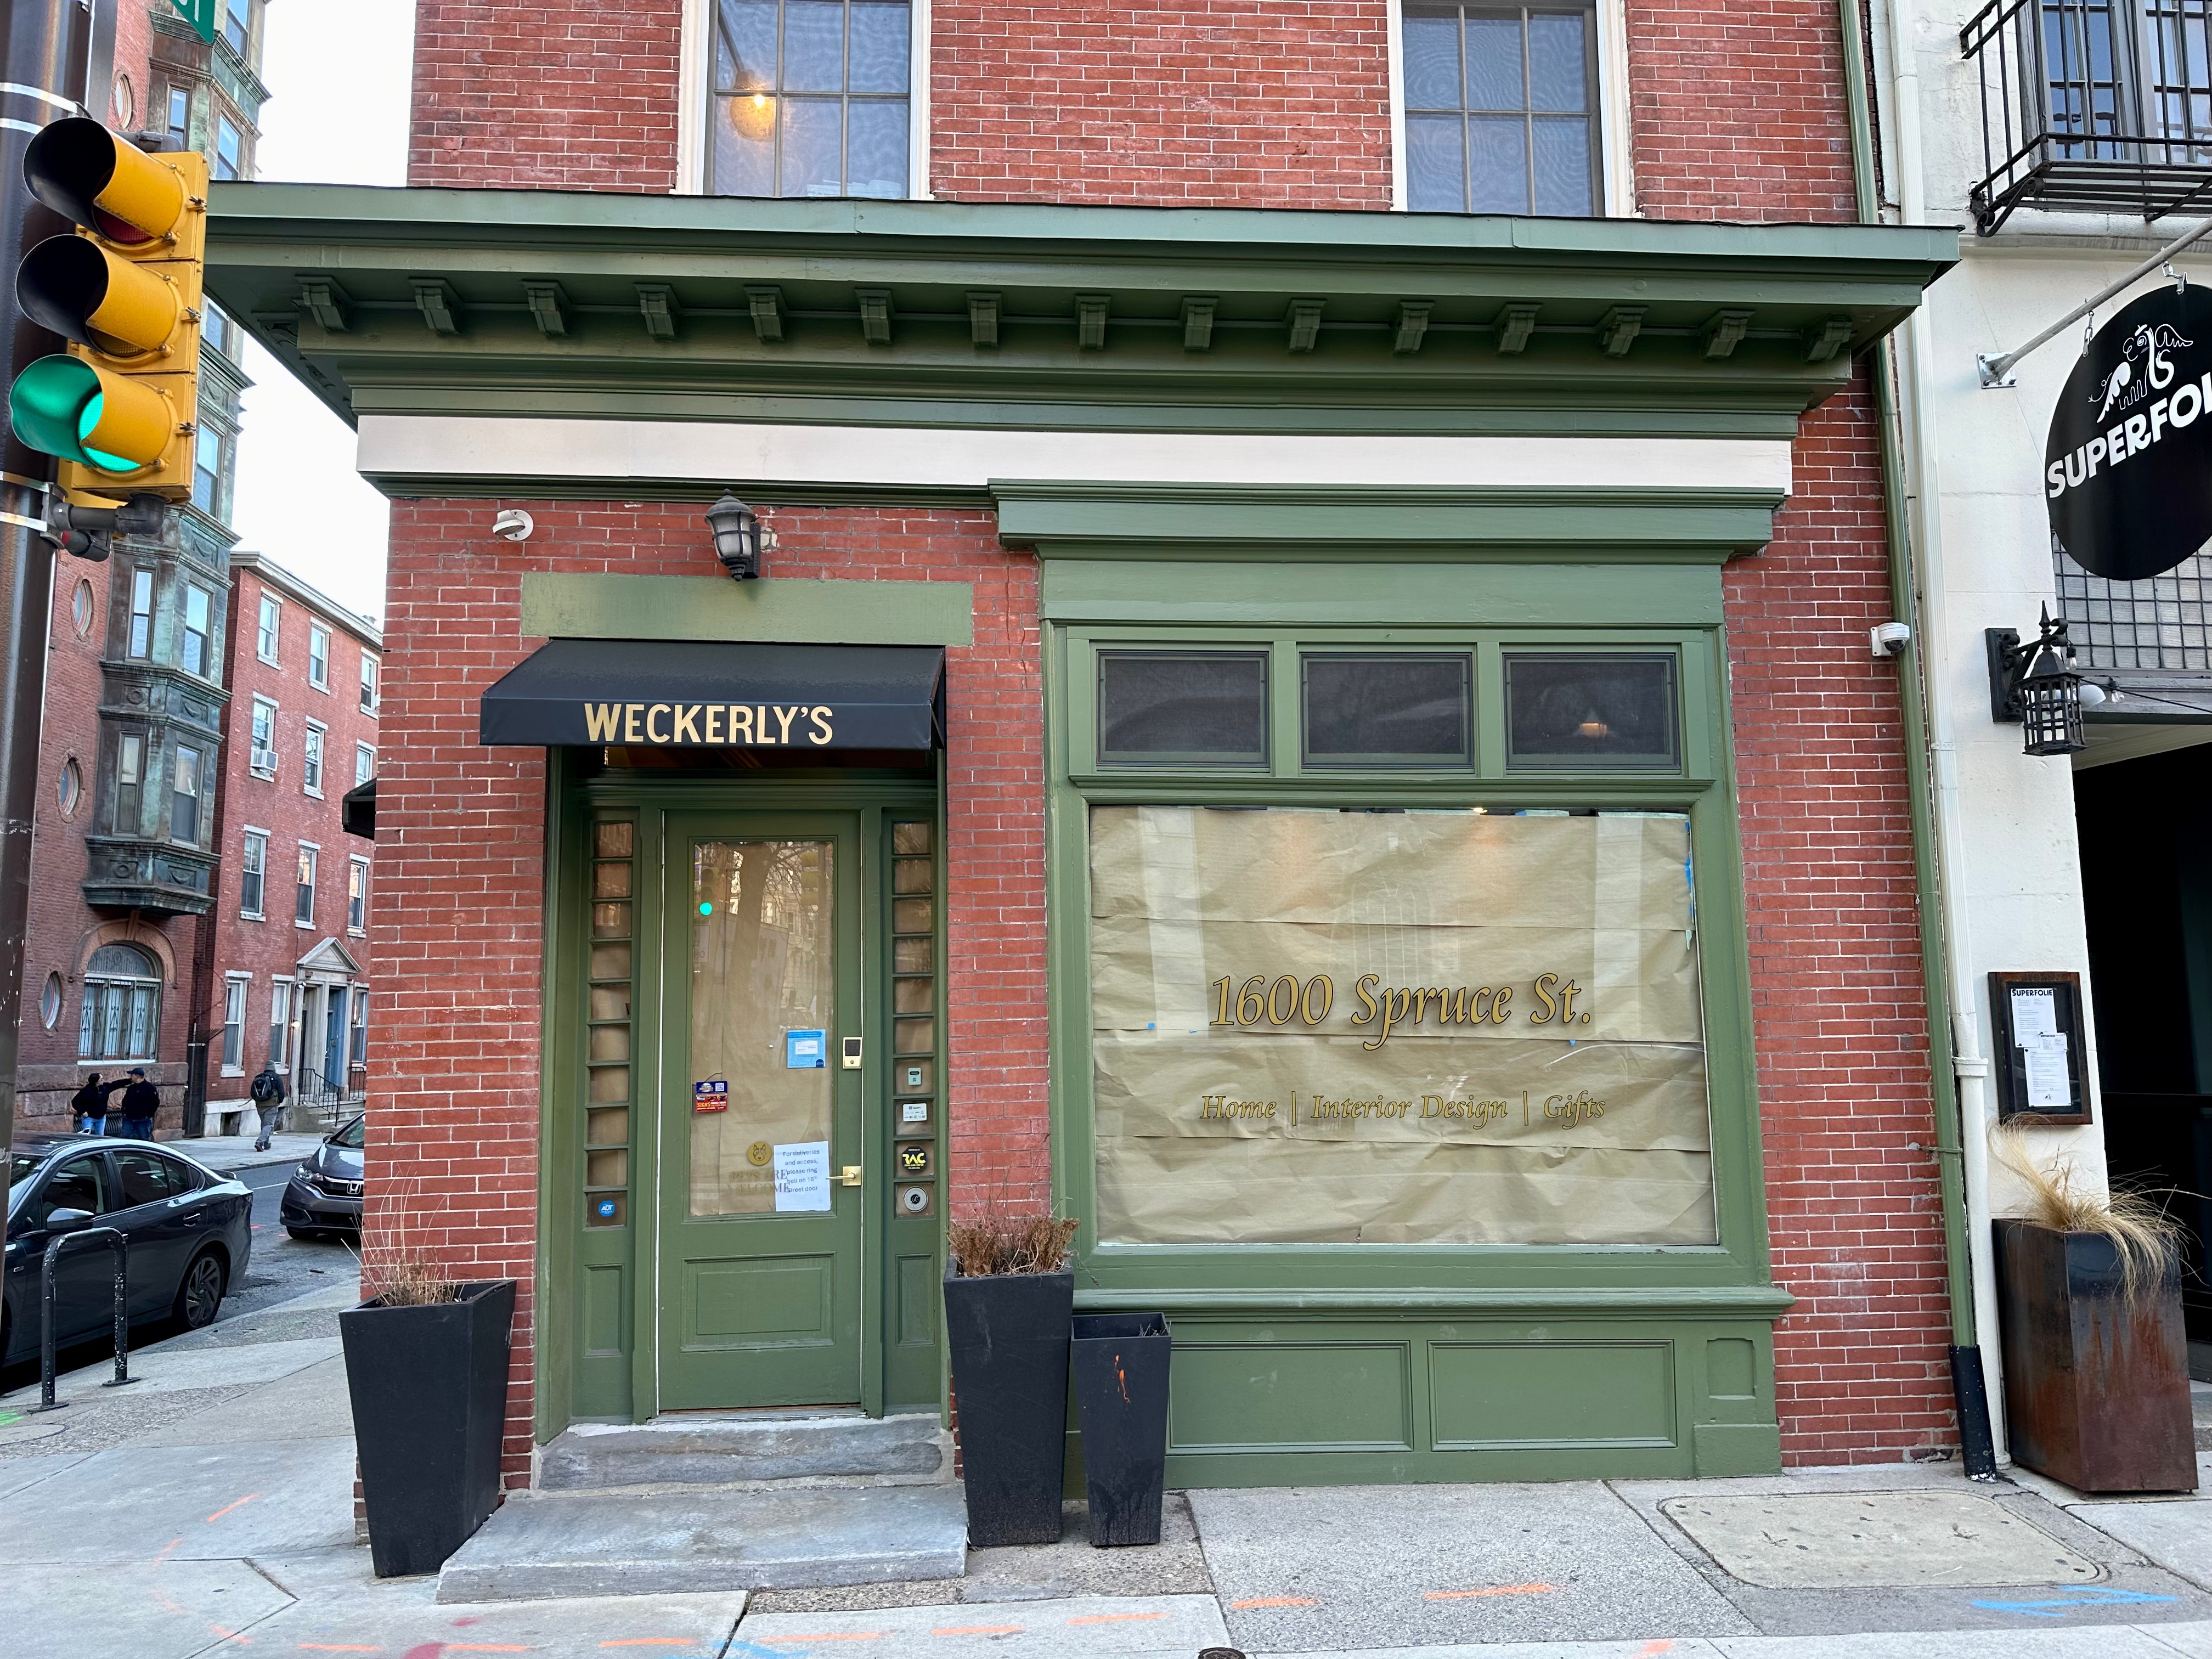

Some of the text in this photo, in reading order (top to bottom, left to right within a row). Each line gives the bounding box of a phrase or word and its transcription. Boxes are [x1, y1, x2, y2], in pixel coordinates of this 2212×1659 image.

[584, 703, 833, 744] WECKERLY'S
[1209, 973, 1592, 1051] 1600 Spruce St.
[1199, 1094, 1277, 1120] Home
[1311, 1094, 1412, 1120] Interior
[1421, 1094, 1508, 1130] Design
[1543, 1090, 1606, 1130] Gifts
